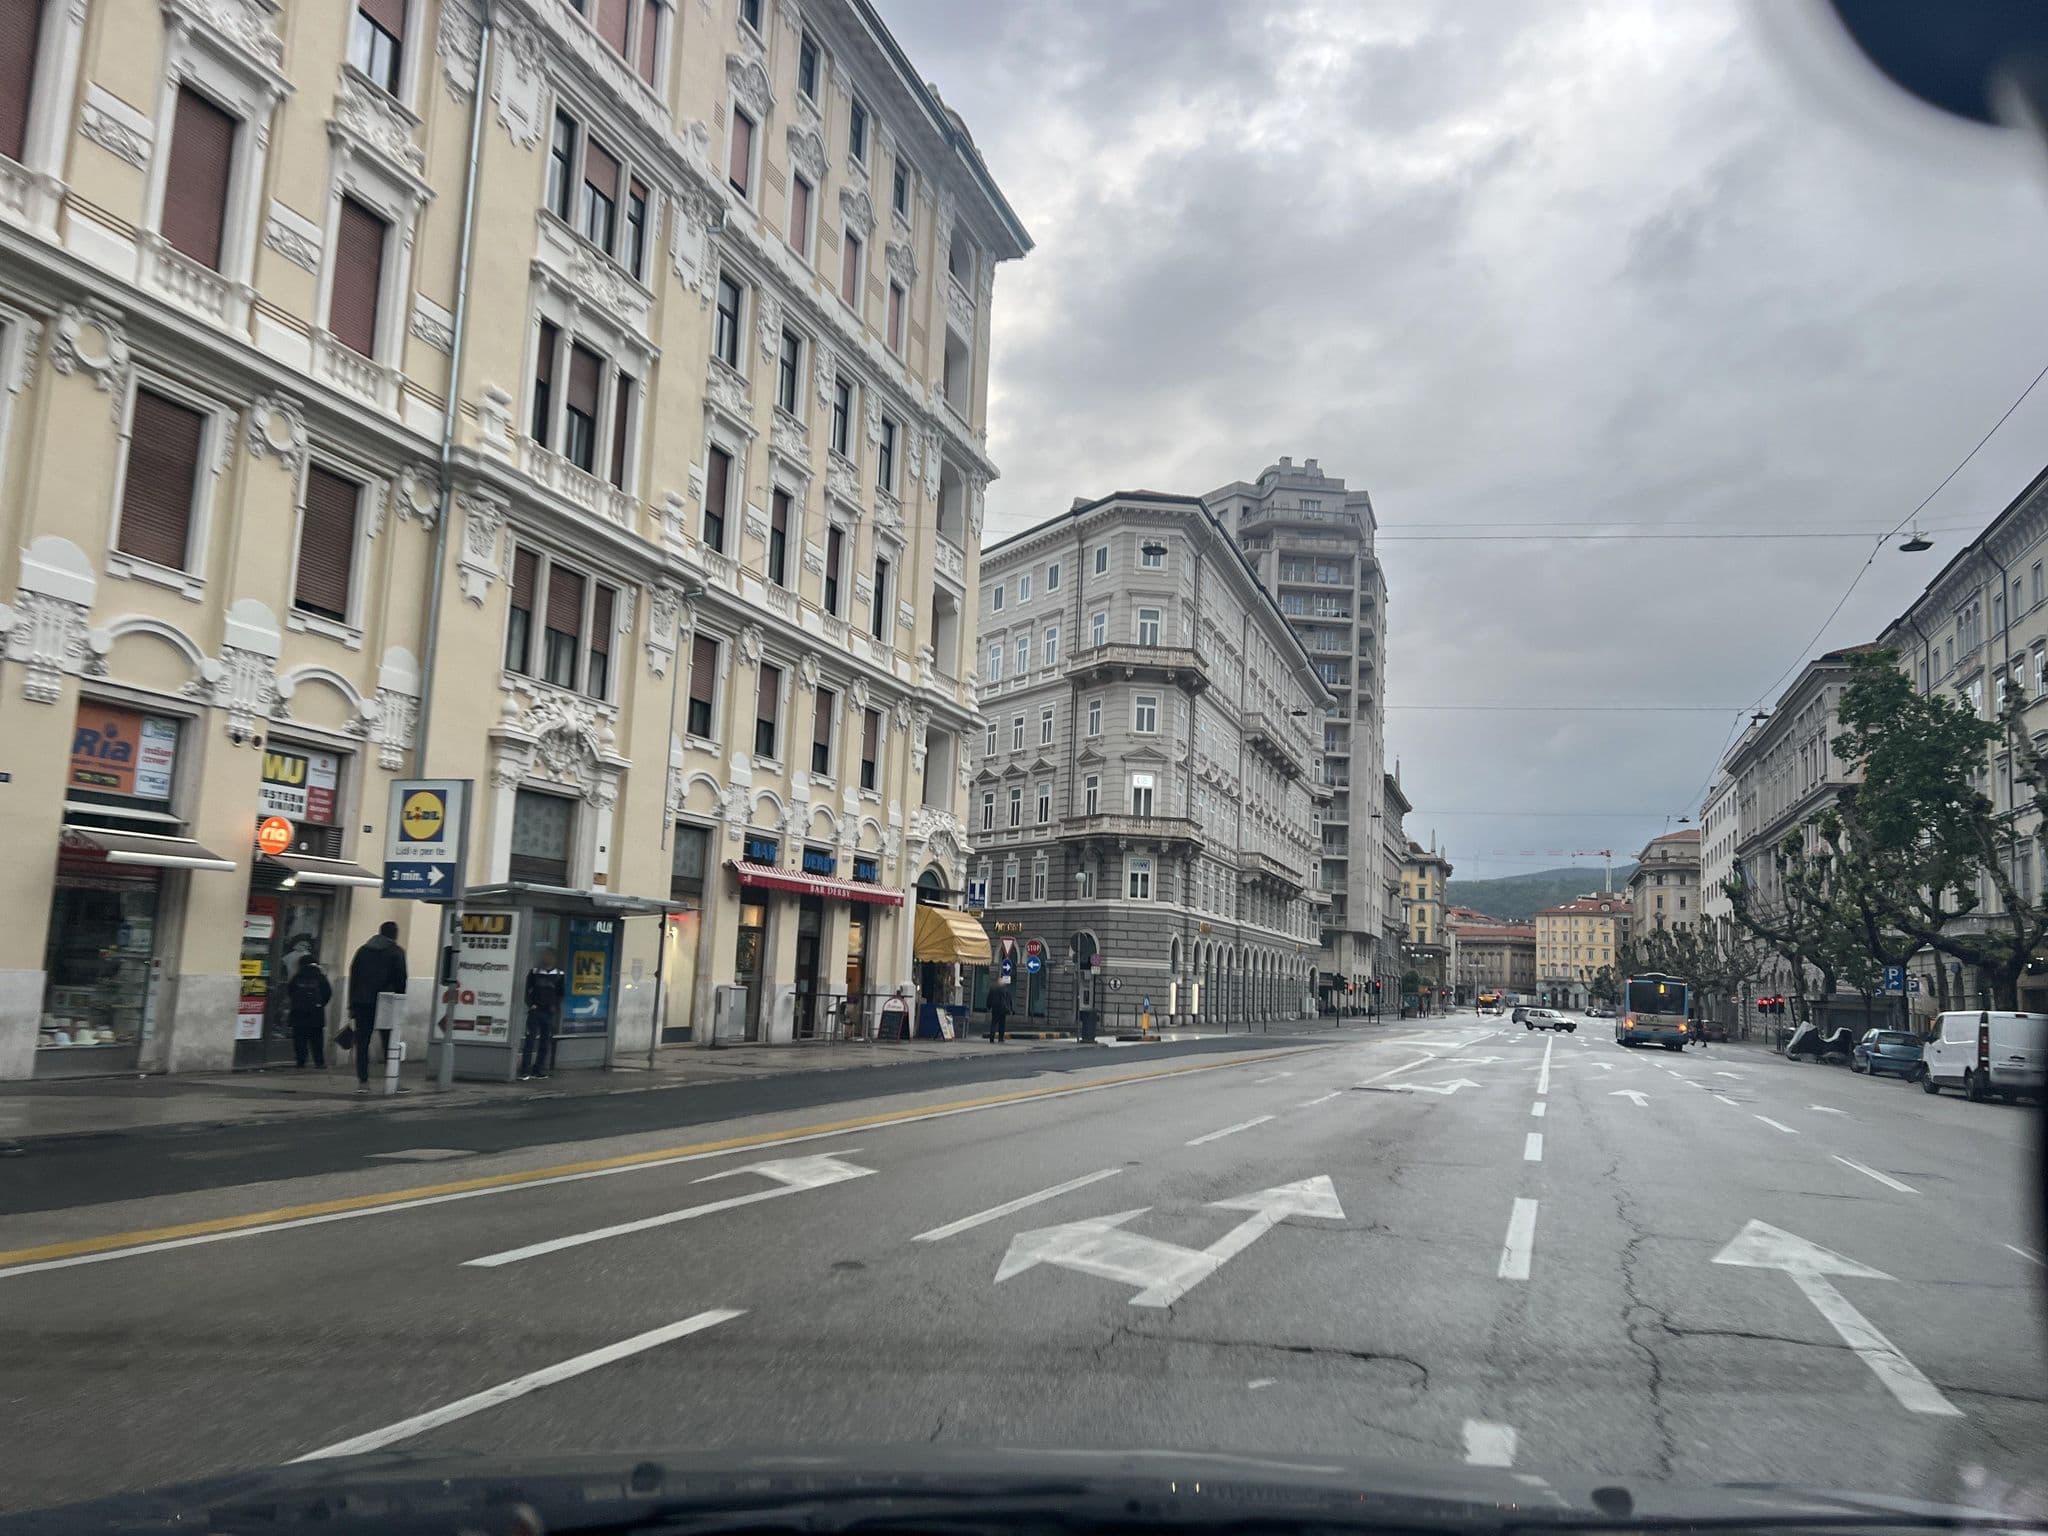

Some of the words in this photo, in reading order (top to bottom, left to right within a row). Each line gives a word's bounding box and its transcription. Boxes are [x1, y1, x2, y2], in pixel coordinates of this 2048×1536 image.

[73, 722, 131, 762] Ria
[262, 753, 304, 784] WU
[268, 800, 303, 813] UNION
[404, 806, 440, 822] LIDL
[261, 821, 288, 841] ria
[419, 847, 434, 858] per
[752, 841, 777, 862] BAR
[805, 852, 836, 877] DERBY
[859, 863, 879, 880] BAR
[391, 870, 400, 880] 3
[401, 870, 424, 881] min.
[809, 885, 825, 895] BAR
[827, 888, 851, 898] DERBY
[463, 915, 505, 933] WU
[462, 936, 509, 944] ESTERN
[1027, 943, 1041, 951] STOP
[1888, 968, 1899, 980] P
[1908, 981, 1918, 991] P
